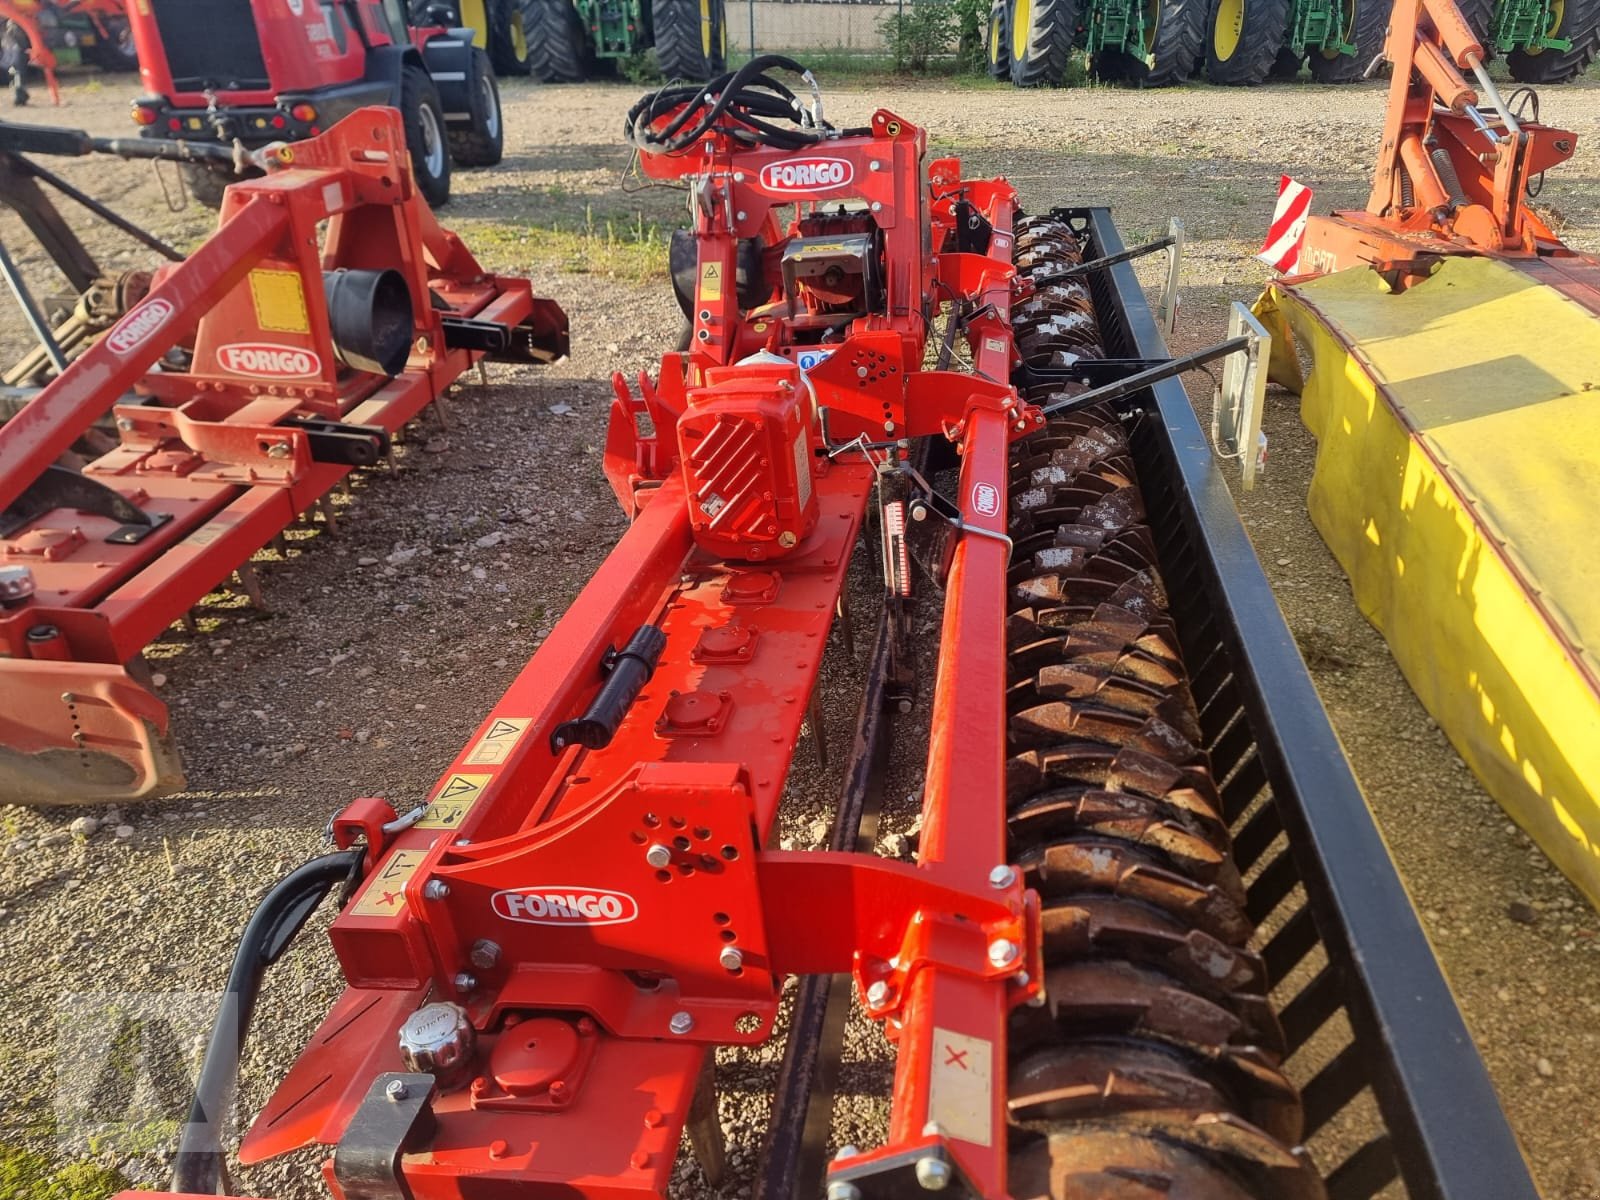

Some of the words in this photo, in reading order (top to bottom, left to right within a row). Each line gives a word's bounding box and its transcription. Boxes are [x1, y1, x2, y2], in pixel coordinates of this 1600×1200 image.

[770, 162, 845, 187] FORIGO
[111, 303, 169, 350] FORIGO
[226, 349, 311, 373] FORIGO
[978, 486, 995, 514] FORIGO
[505, 894, 623, 919] FORIGO
